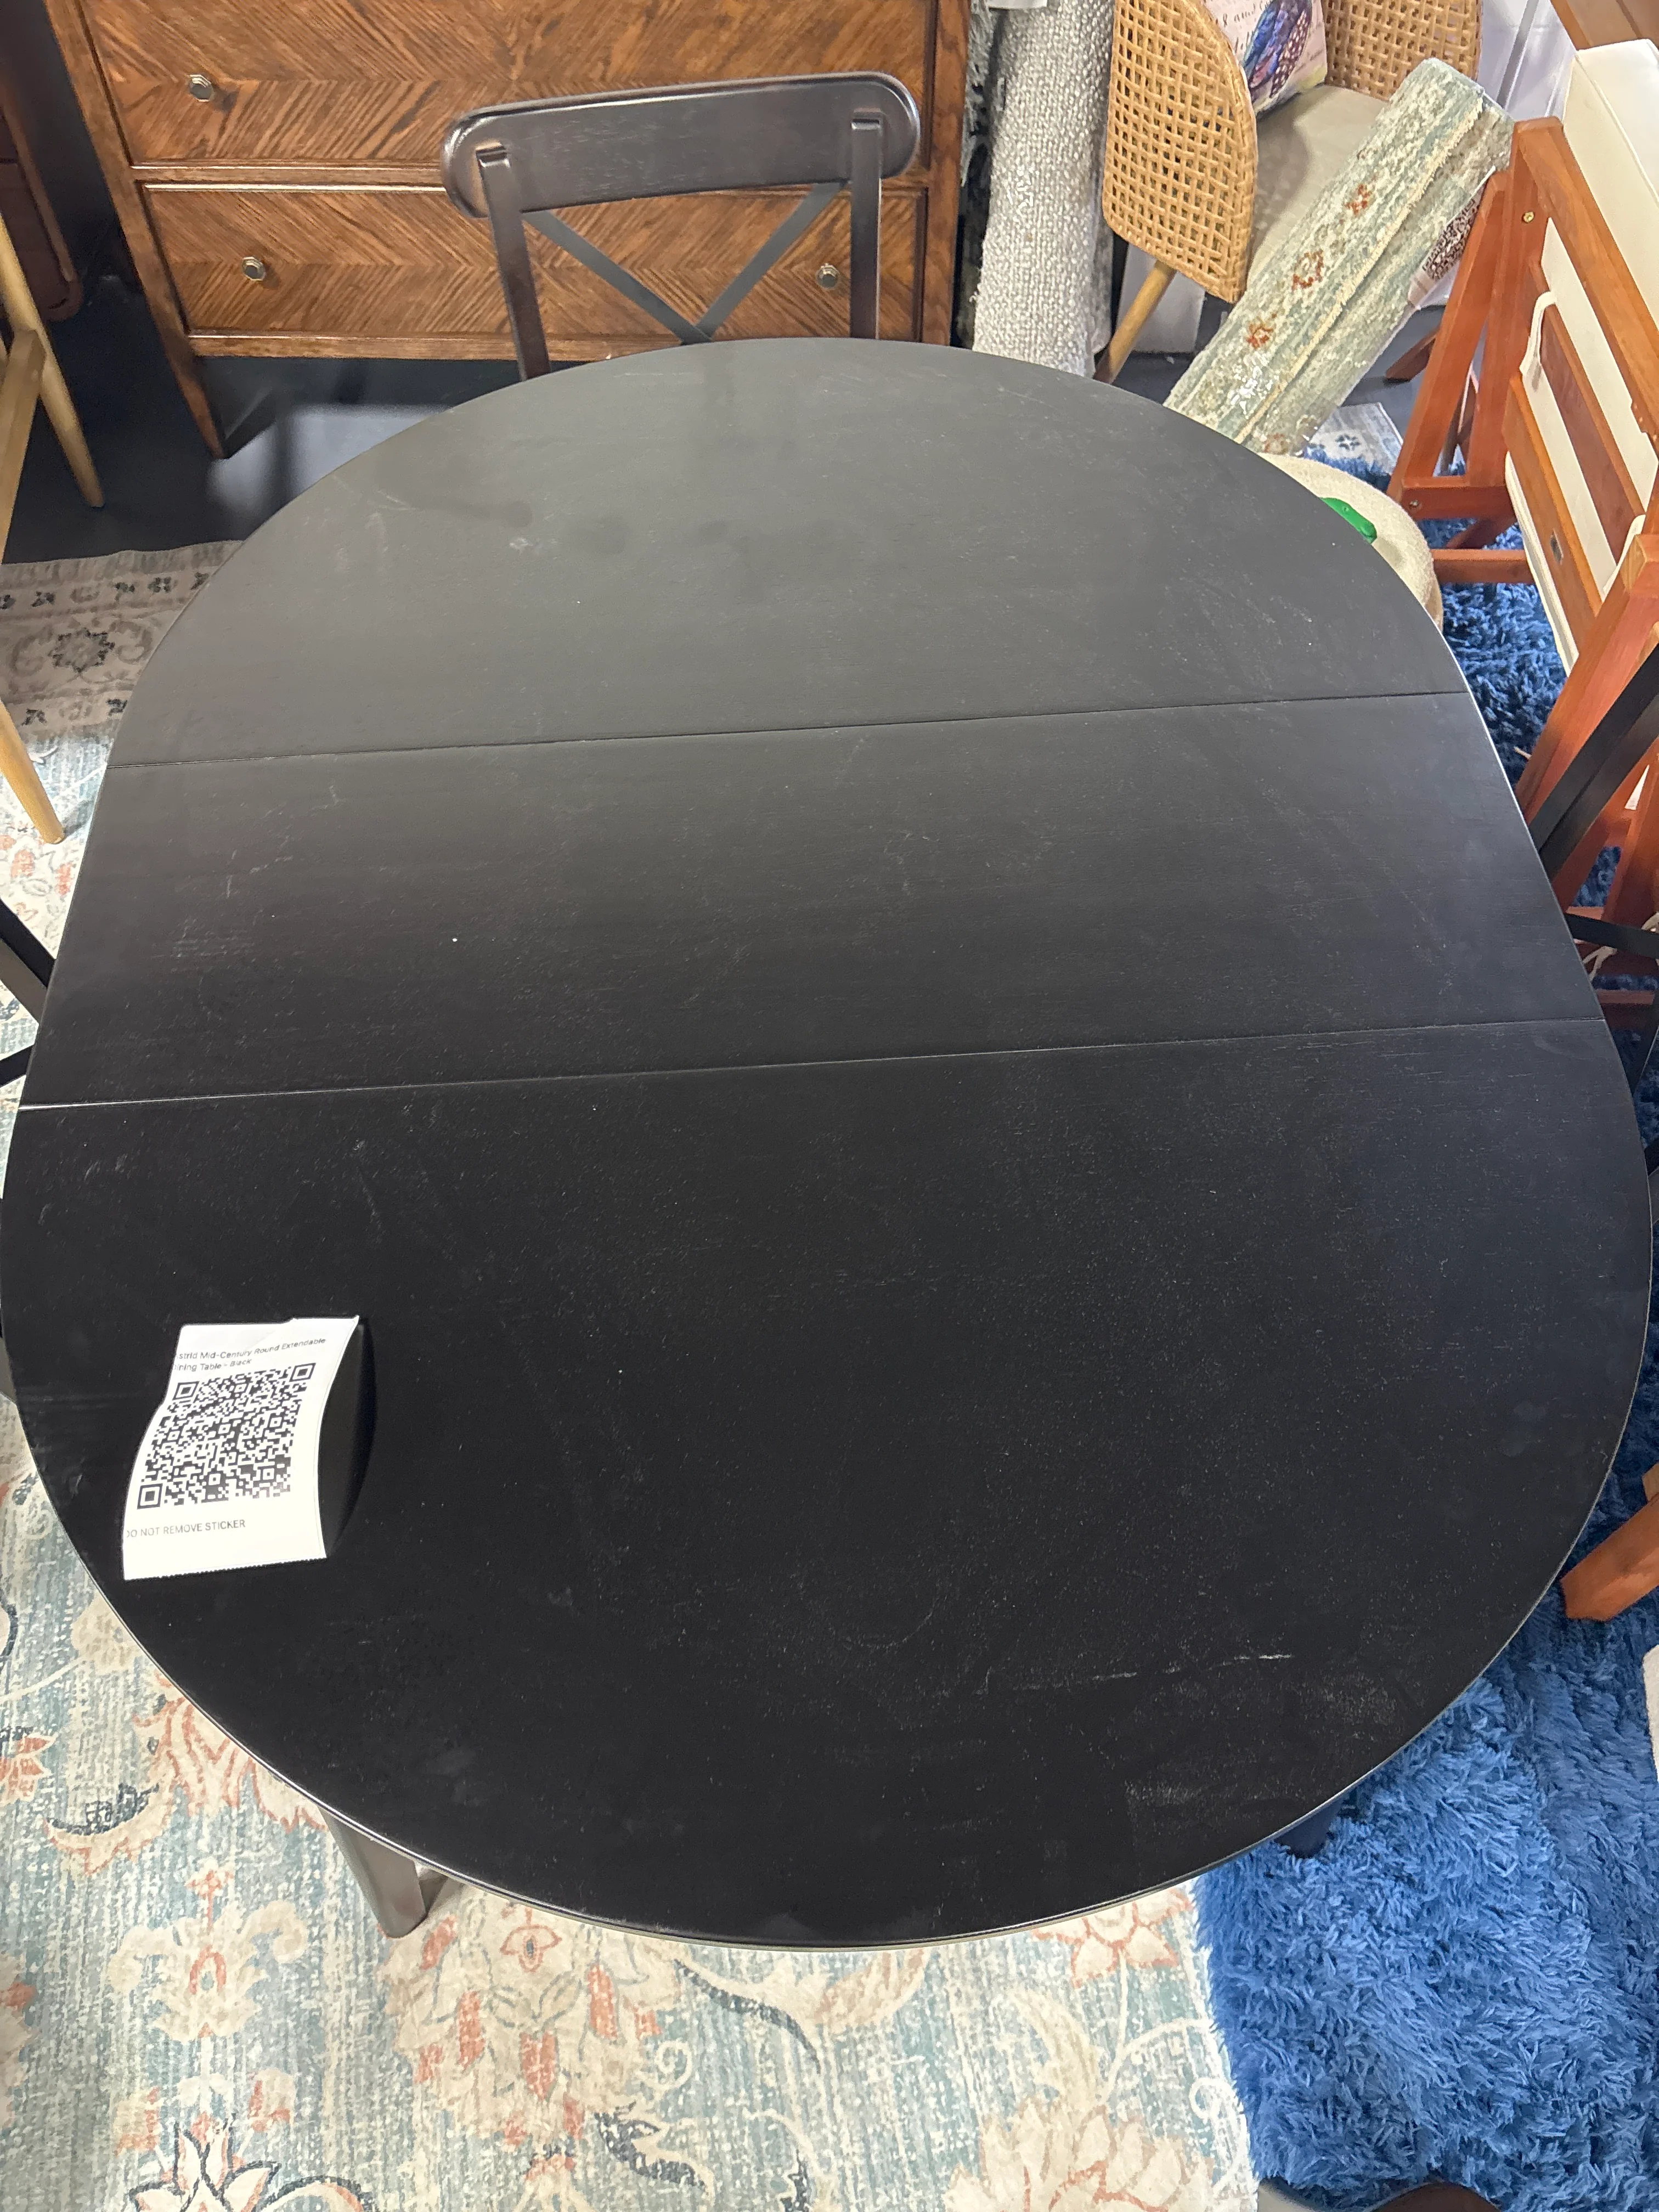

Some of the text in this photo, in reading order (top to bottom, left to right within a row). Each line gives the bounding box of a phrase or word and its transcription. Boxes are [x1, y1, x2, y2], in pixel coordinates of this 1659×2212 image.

[200, 1349, 252, 1359] Mid-Century
[254, 1344, 280, 1355] Round
[281, 1338, 326, 1350] Extendable
[200, 1363, 222, 1371] Table
[230, 1358, 252, 1367] Black
[140, 1527, 160, 1537] NOT
[163, 1523, 203, 1534] REMOVE
[205, 1519, 246, 1531] STICKER
